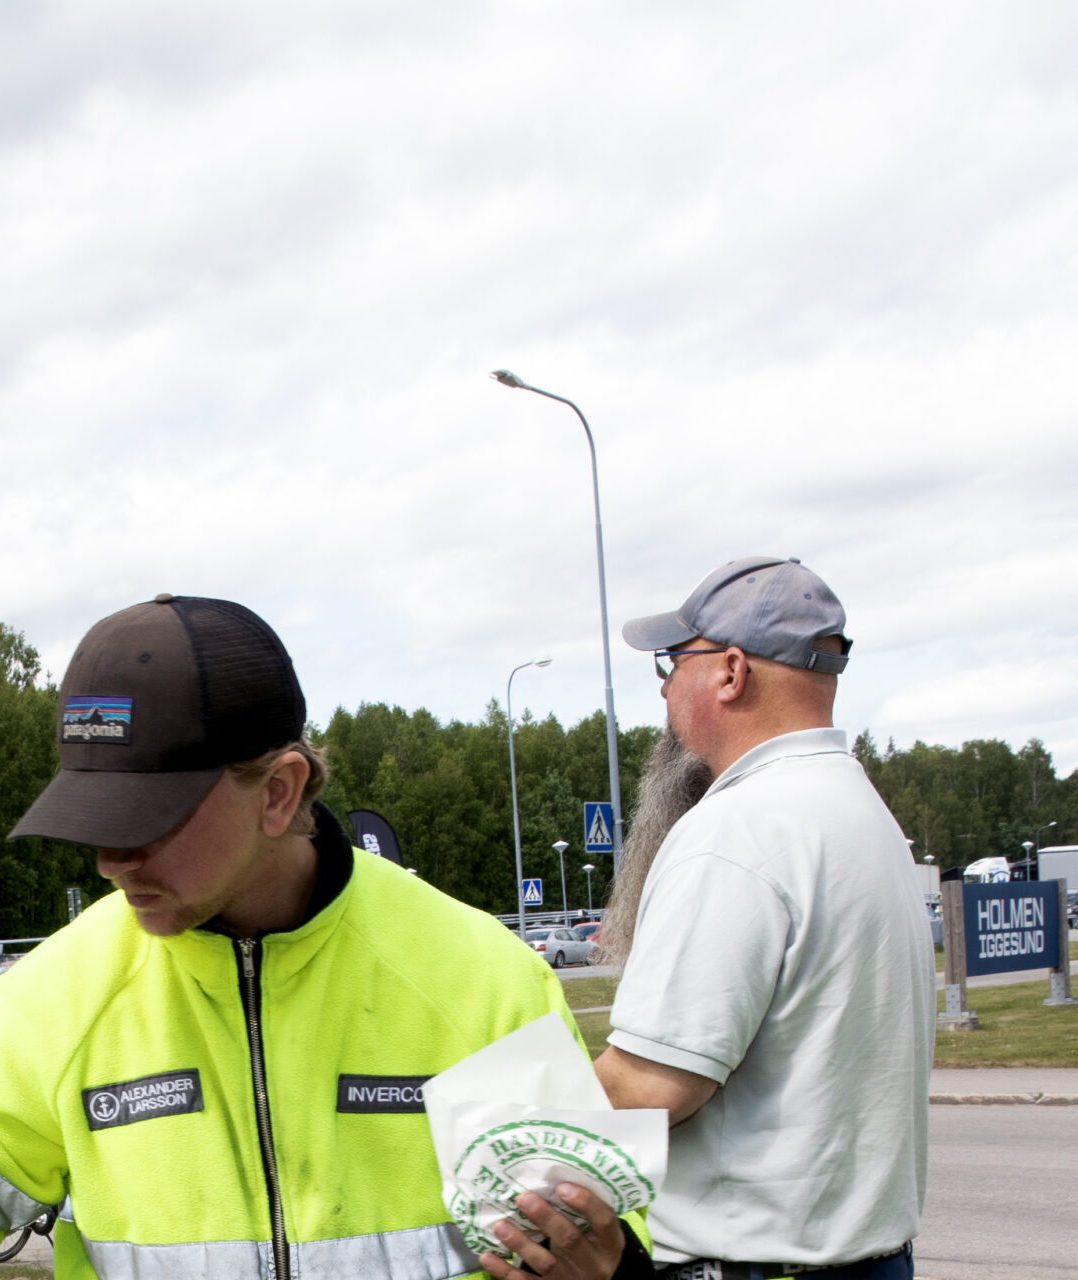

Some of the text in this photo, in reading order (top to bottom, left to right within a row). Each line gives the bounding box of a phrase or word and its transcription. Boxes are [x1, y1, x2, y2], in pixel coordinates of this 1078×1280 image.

[978, 897, 1044, 931] HOLMEN
[978, 930, 1044, 959] IGGESUND
[121, 1078, 194, 1103] ALEXANDER
[128, 1092, 187, 1114] LARSSON
